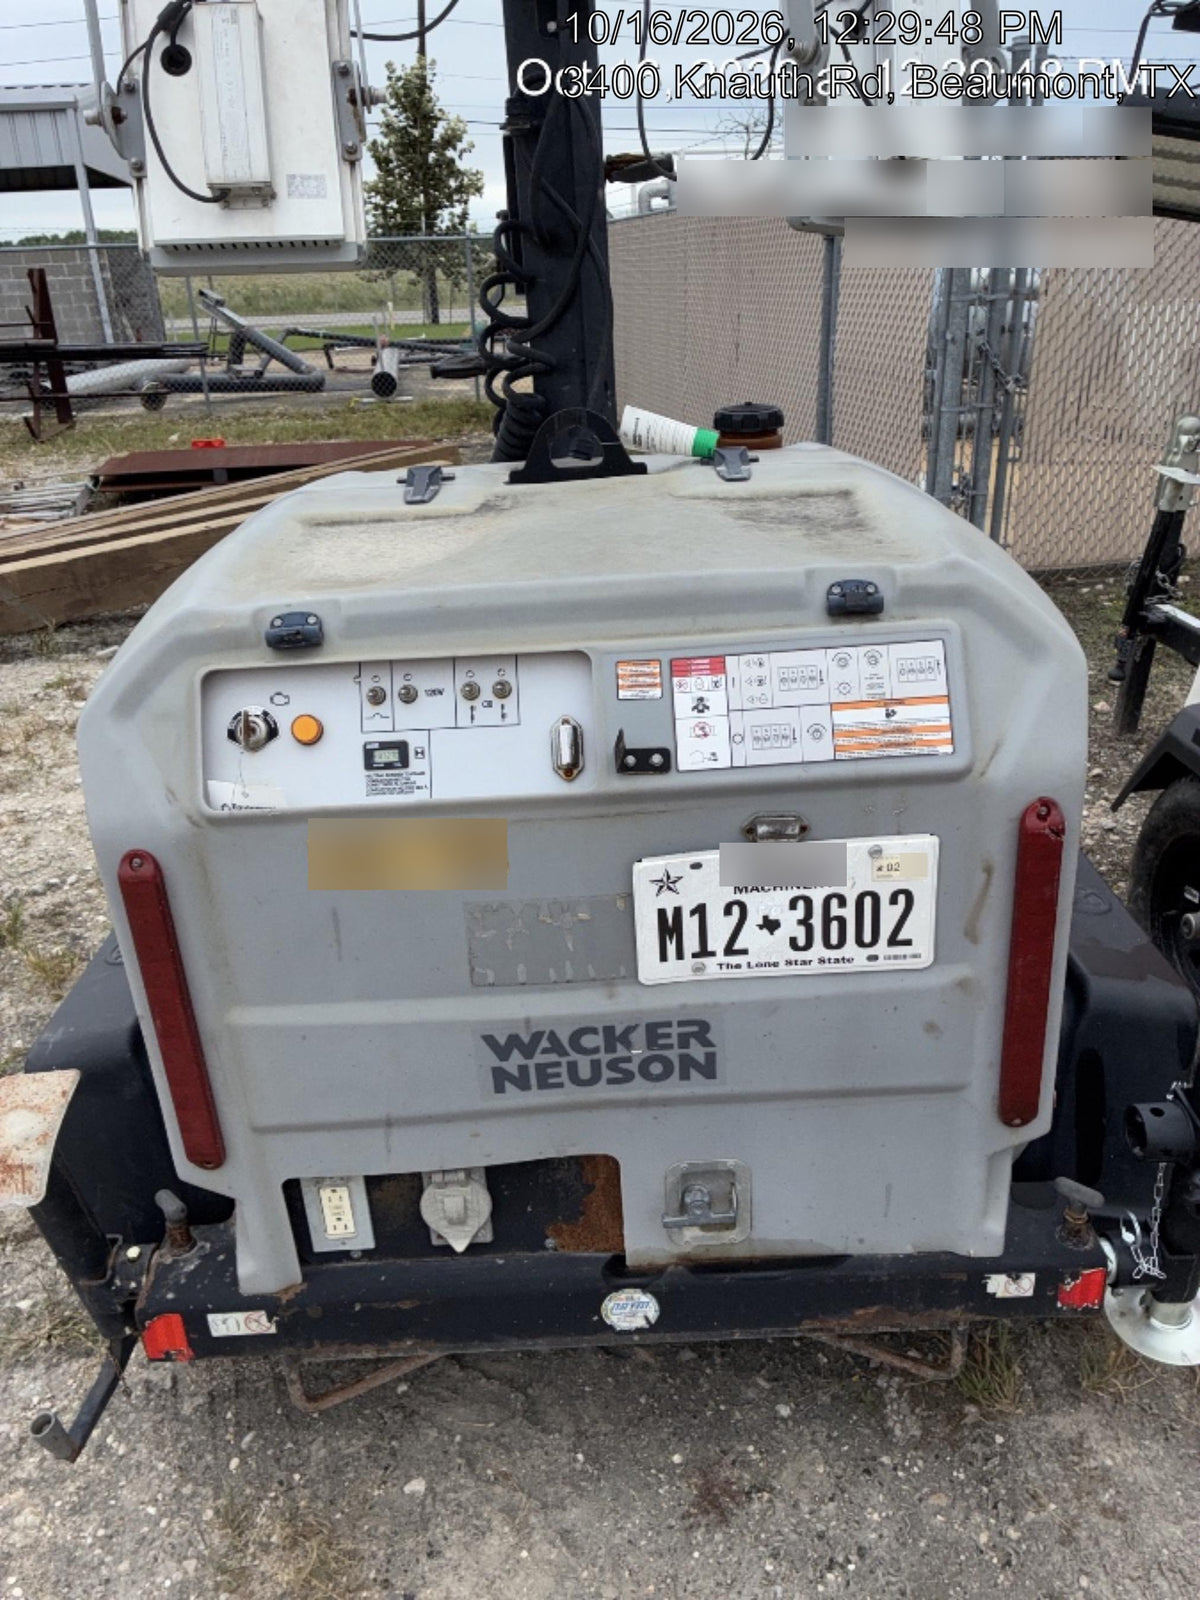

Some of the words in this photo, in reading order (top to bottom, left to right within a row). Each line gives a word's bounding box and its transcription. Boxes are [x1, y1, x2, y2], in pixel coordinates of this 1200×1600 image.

[657, 898, 750, 963] M12
[787, 888, 915, 953] 3602
[716, 962, 742, 971] The
[746, 960, 780, 970] Lone
[784, 958, 813, 967] Star
[817, 956, 855, 966] State
[480, 1018, 717, 1062] WACKER
[491, 1052, 717, 1094] NEUSON
